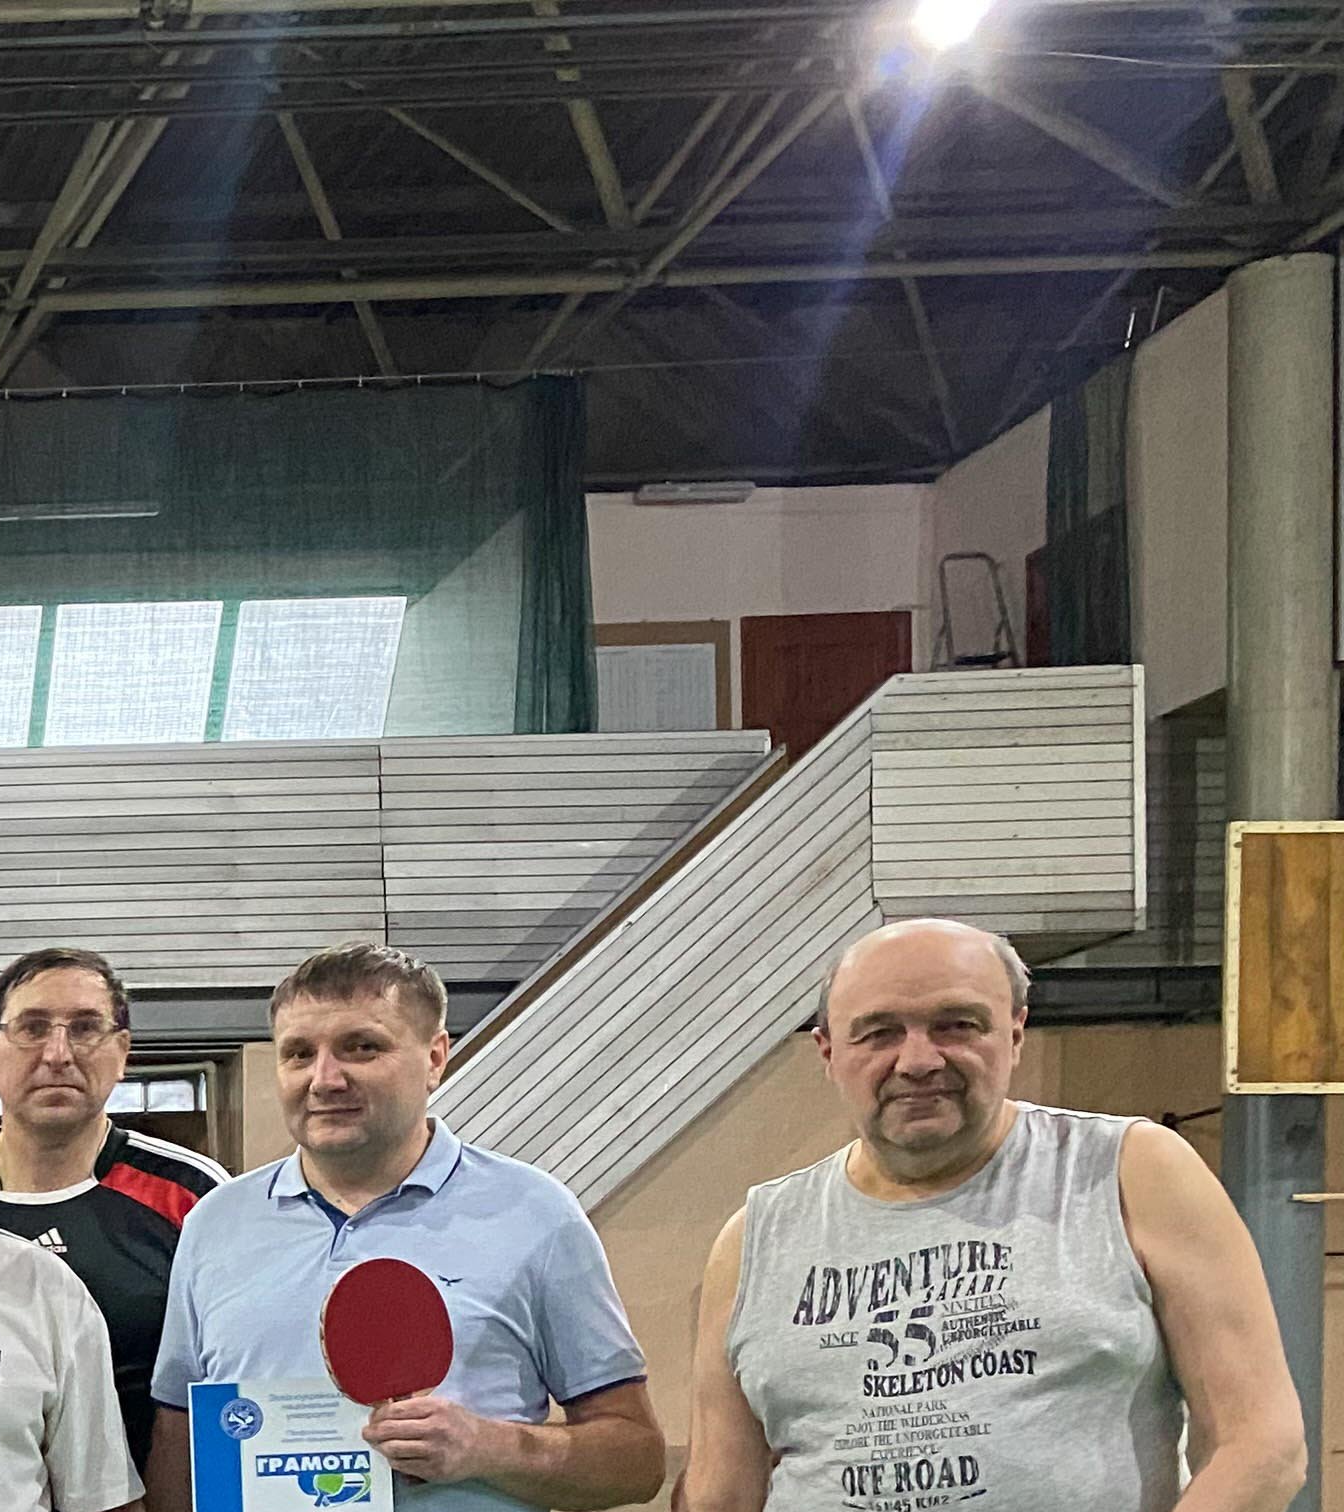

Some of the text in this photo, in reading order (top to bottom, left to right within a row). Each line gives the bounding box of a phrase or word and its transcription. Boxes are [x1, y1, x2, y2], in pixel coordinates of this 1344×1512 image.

[793, 1240, 1013, 1325] ADVENTURE
[819, 1331, 859, 1349] SINCE
[863, 1349, 1038, 1398] SKELETON COAST
[862, 1400, 948, 1419] NATIONAL PARK
[258, 1453, 370, 1475] ГРАМОТА
[842, 1455, 980, 1497] OFF ROAD
